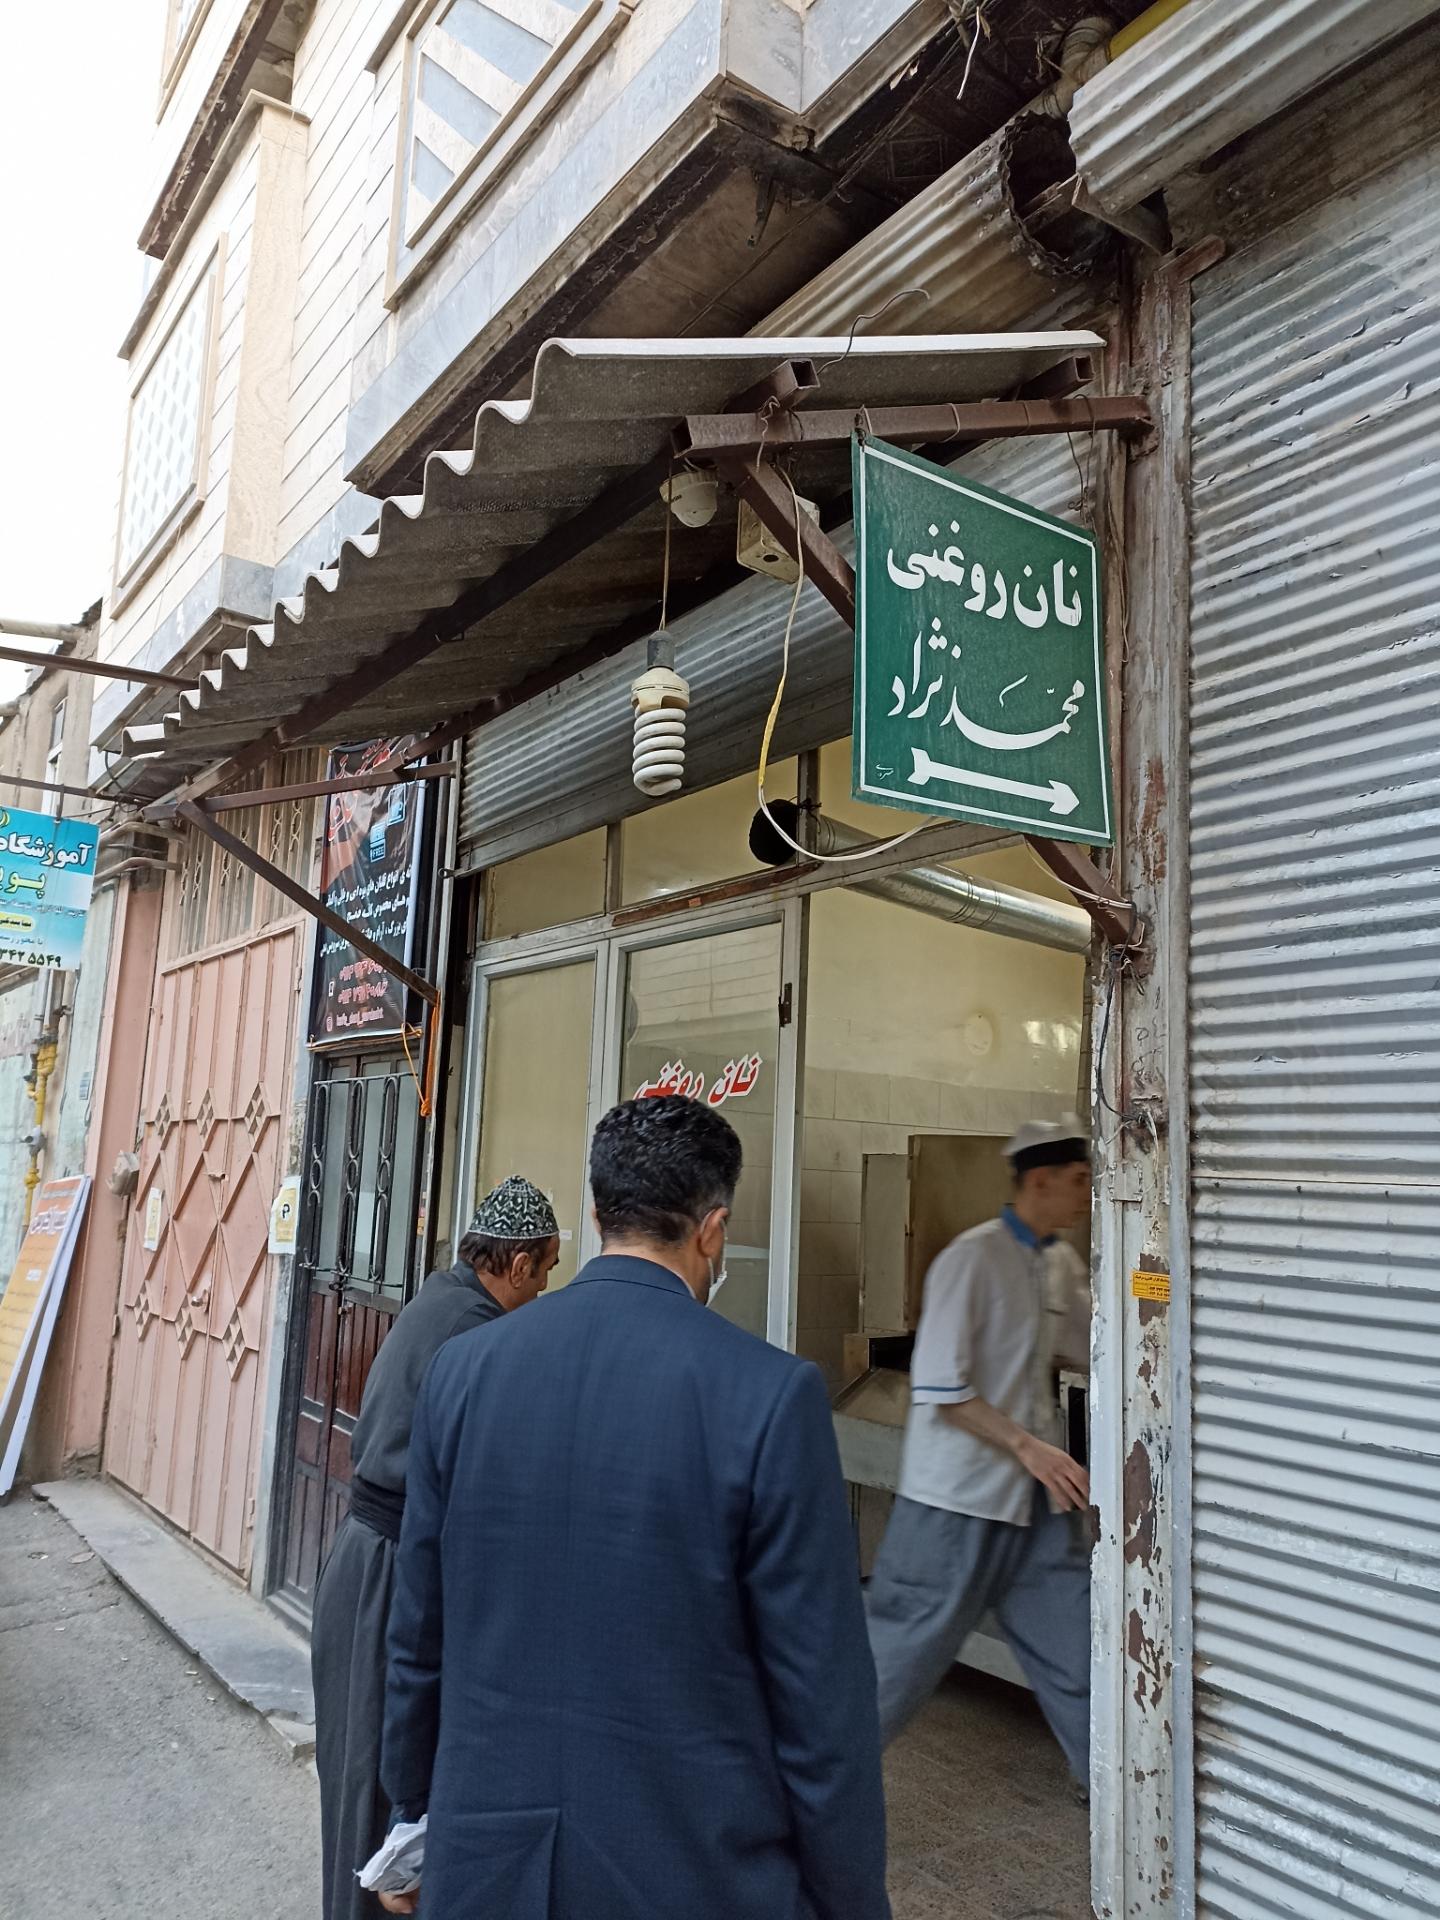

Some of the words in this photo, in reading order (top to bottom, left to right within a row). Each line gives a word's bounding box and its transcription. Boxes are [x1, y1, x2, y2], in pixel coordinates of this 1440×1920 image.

[887, 520, 1008, 621] روغنی
[1013, 558, 1082, 629] نان
[887, 616, 962, 720] نژاد
[707, 1051, 764, 1108] نان
